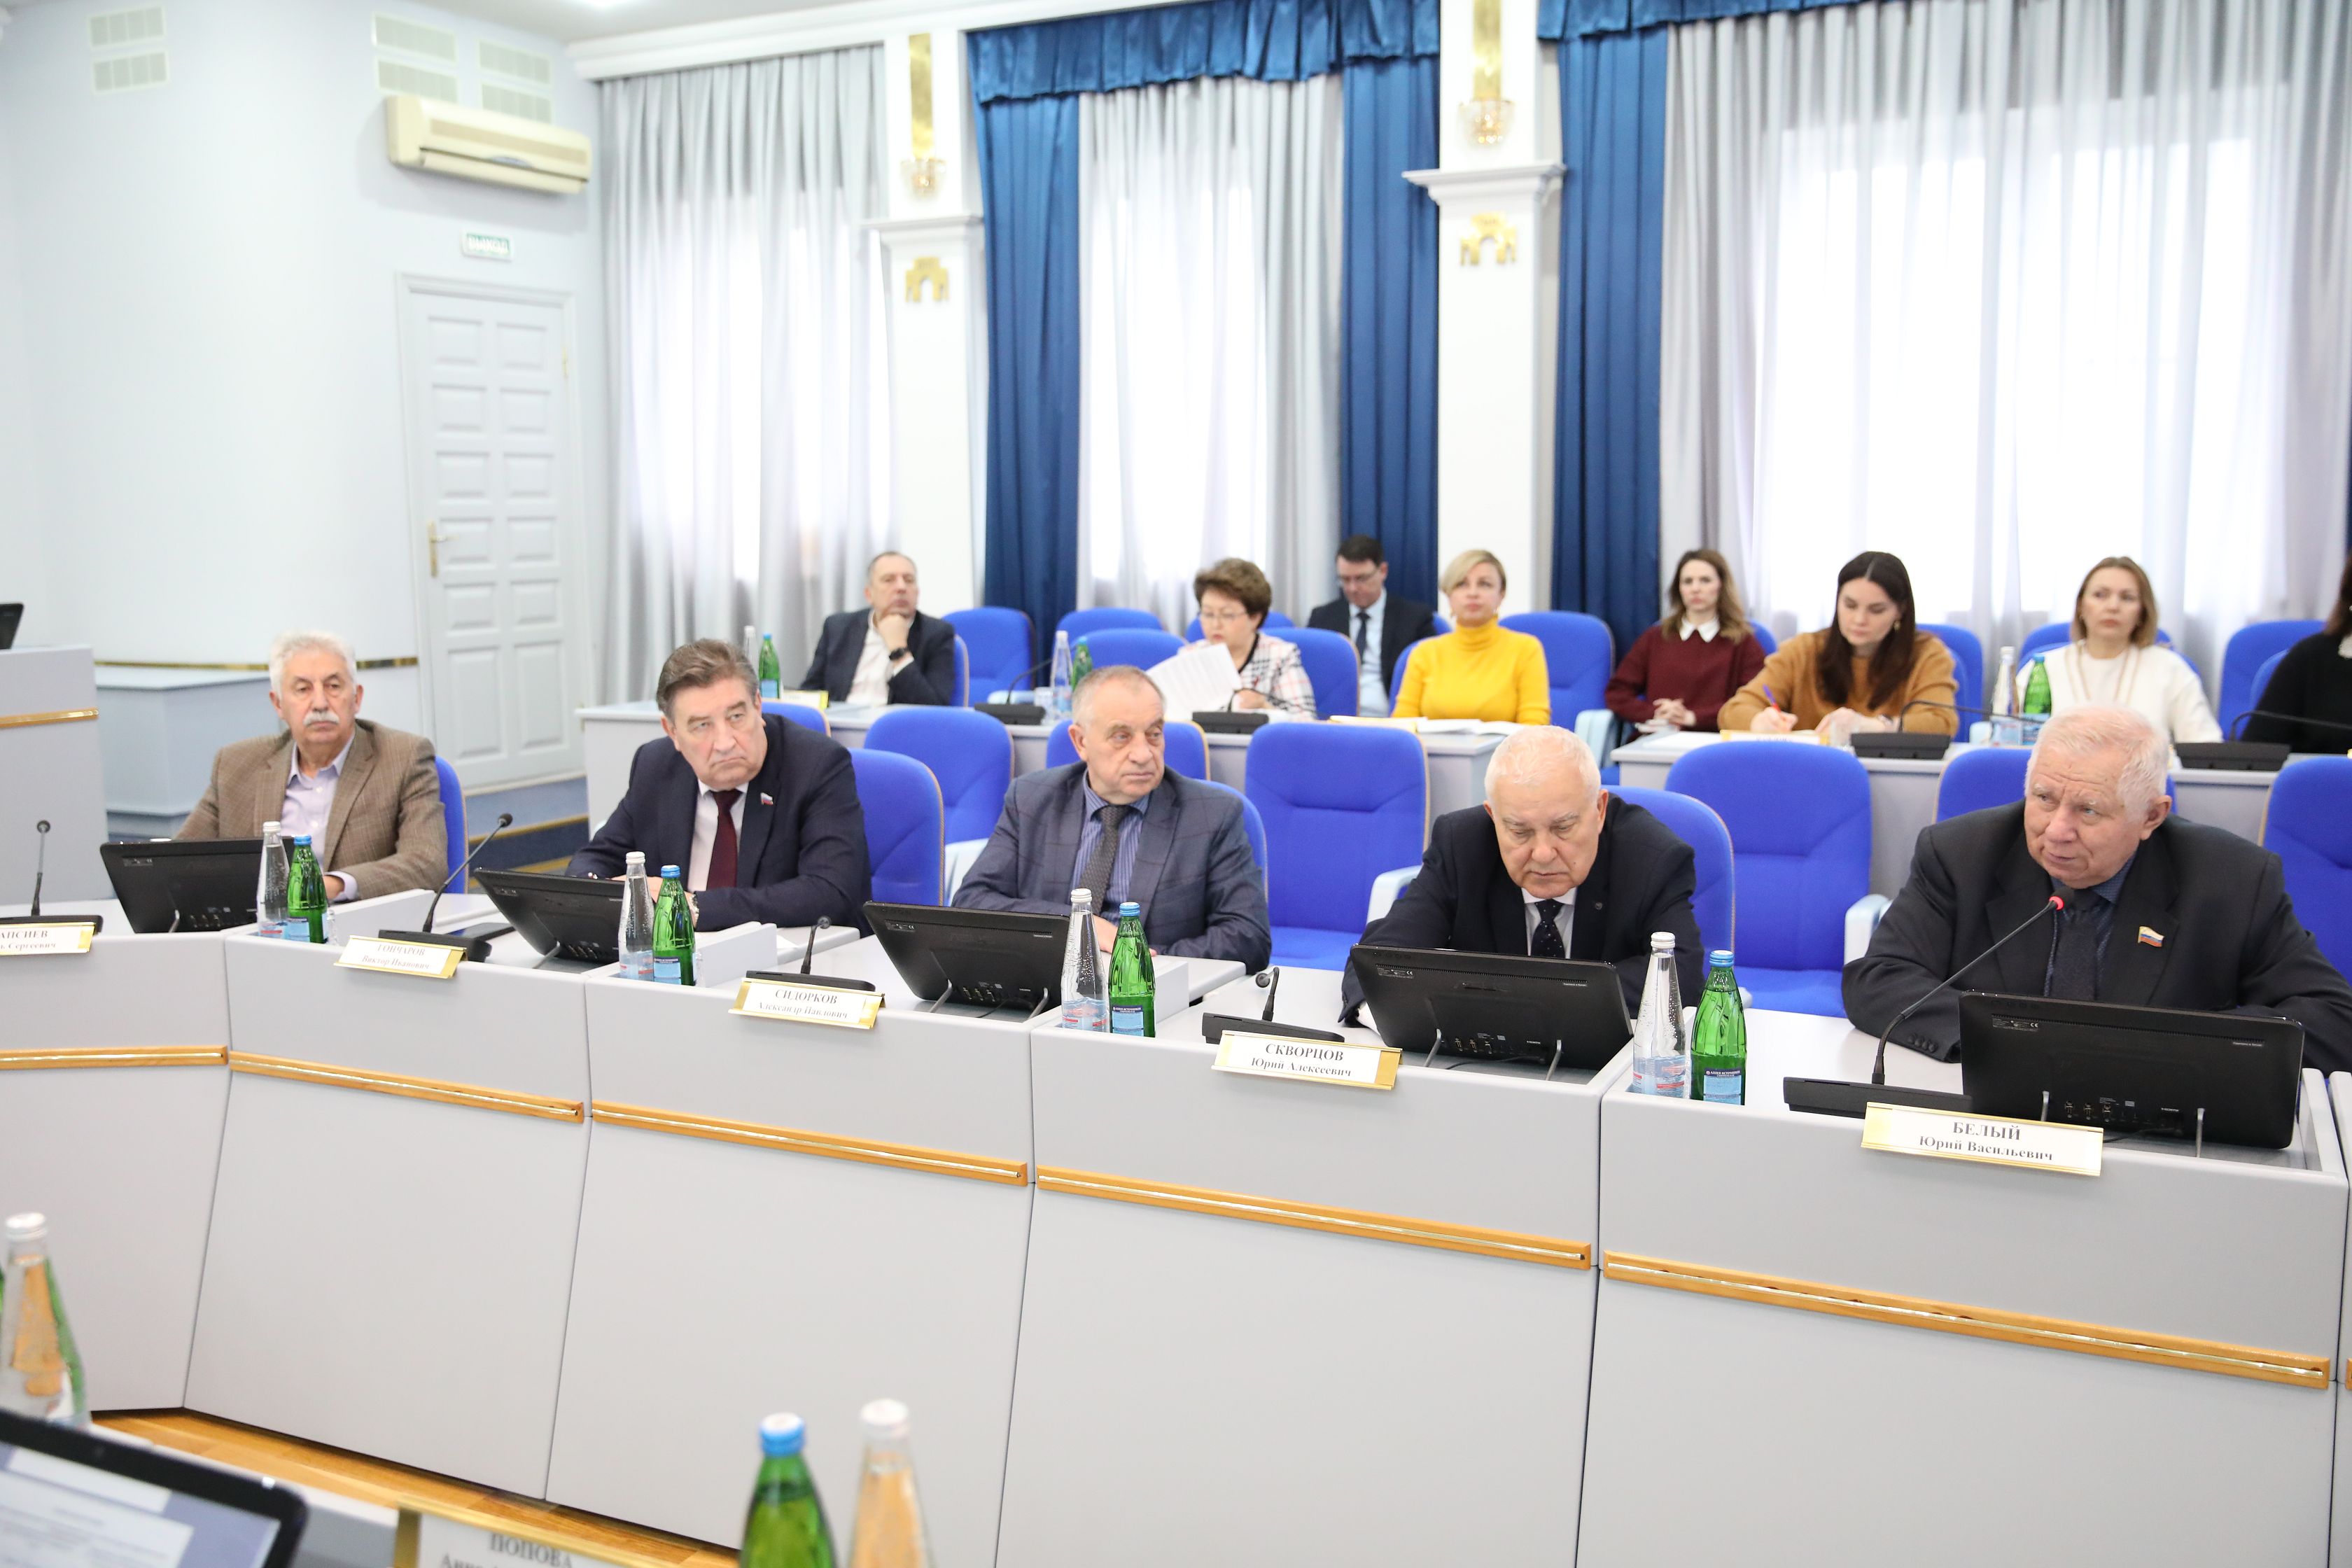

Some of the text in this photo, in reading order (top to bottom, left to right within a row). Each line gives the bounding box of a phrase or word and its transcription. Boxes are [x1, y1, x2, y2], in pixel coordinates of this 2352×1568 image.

[378, 944, 426, 956] ГОНЧАРОВ
[362, 955, 430, 969] Виктор Иванович
[775, 989, 838, 1004] СИДОРКОВ
[758, 1002, 848, 1019] Александр Павлович
[1266, 1043, 1344, 1062] СКВОРЦОВ
[1252, 1058, 1352, 1077] Юрий Алексеевич
[1952, 1121, 2022, 1140] БЕЛЫЙ
[1919, 1135, 2053, 1161] Юрий Васильевич
[490, 1532, 573, 1568] ПОПОВА
